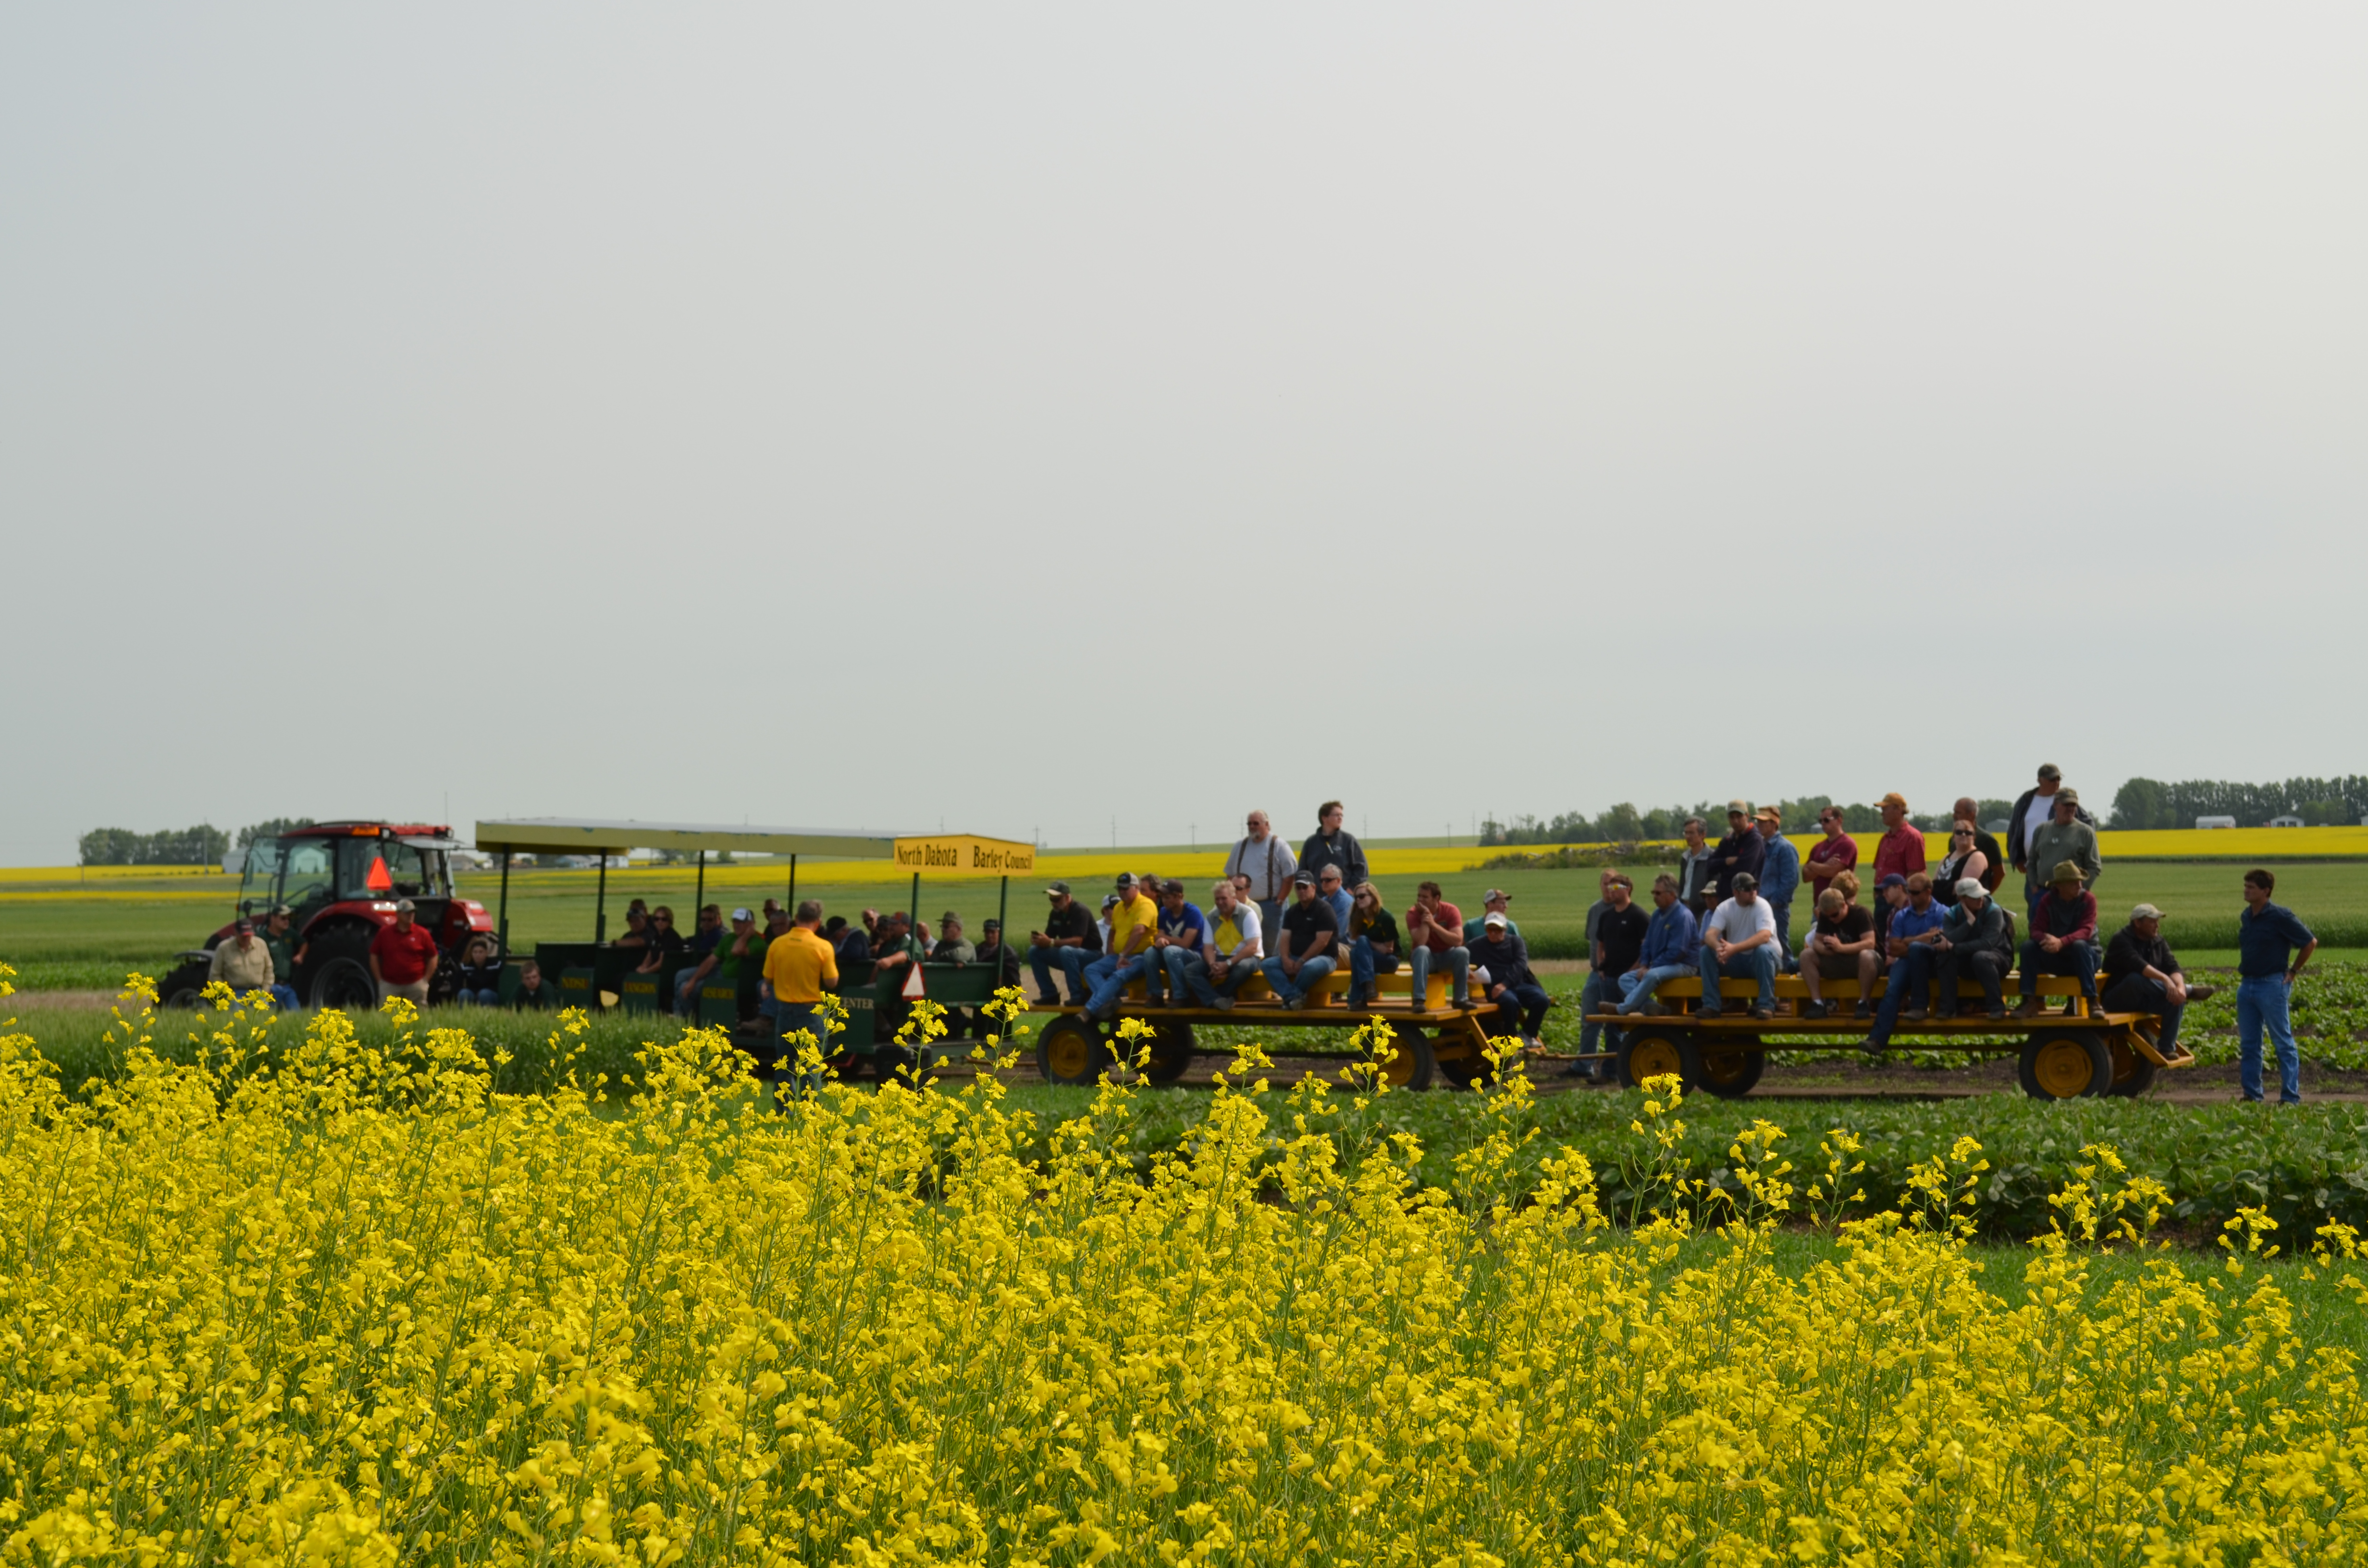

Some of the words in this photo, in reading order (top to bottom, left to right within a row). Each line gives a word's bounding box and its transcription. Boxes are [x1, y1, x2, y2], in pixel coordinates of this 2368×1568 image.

[897, 845, 922, 866] North
[925, 845, 957, 867] Dakota
[974, 845, 1002, 873] Barley
[1005, 850, 1033, 869] Council
